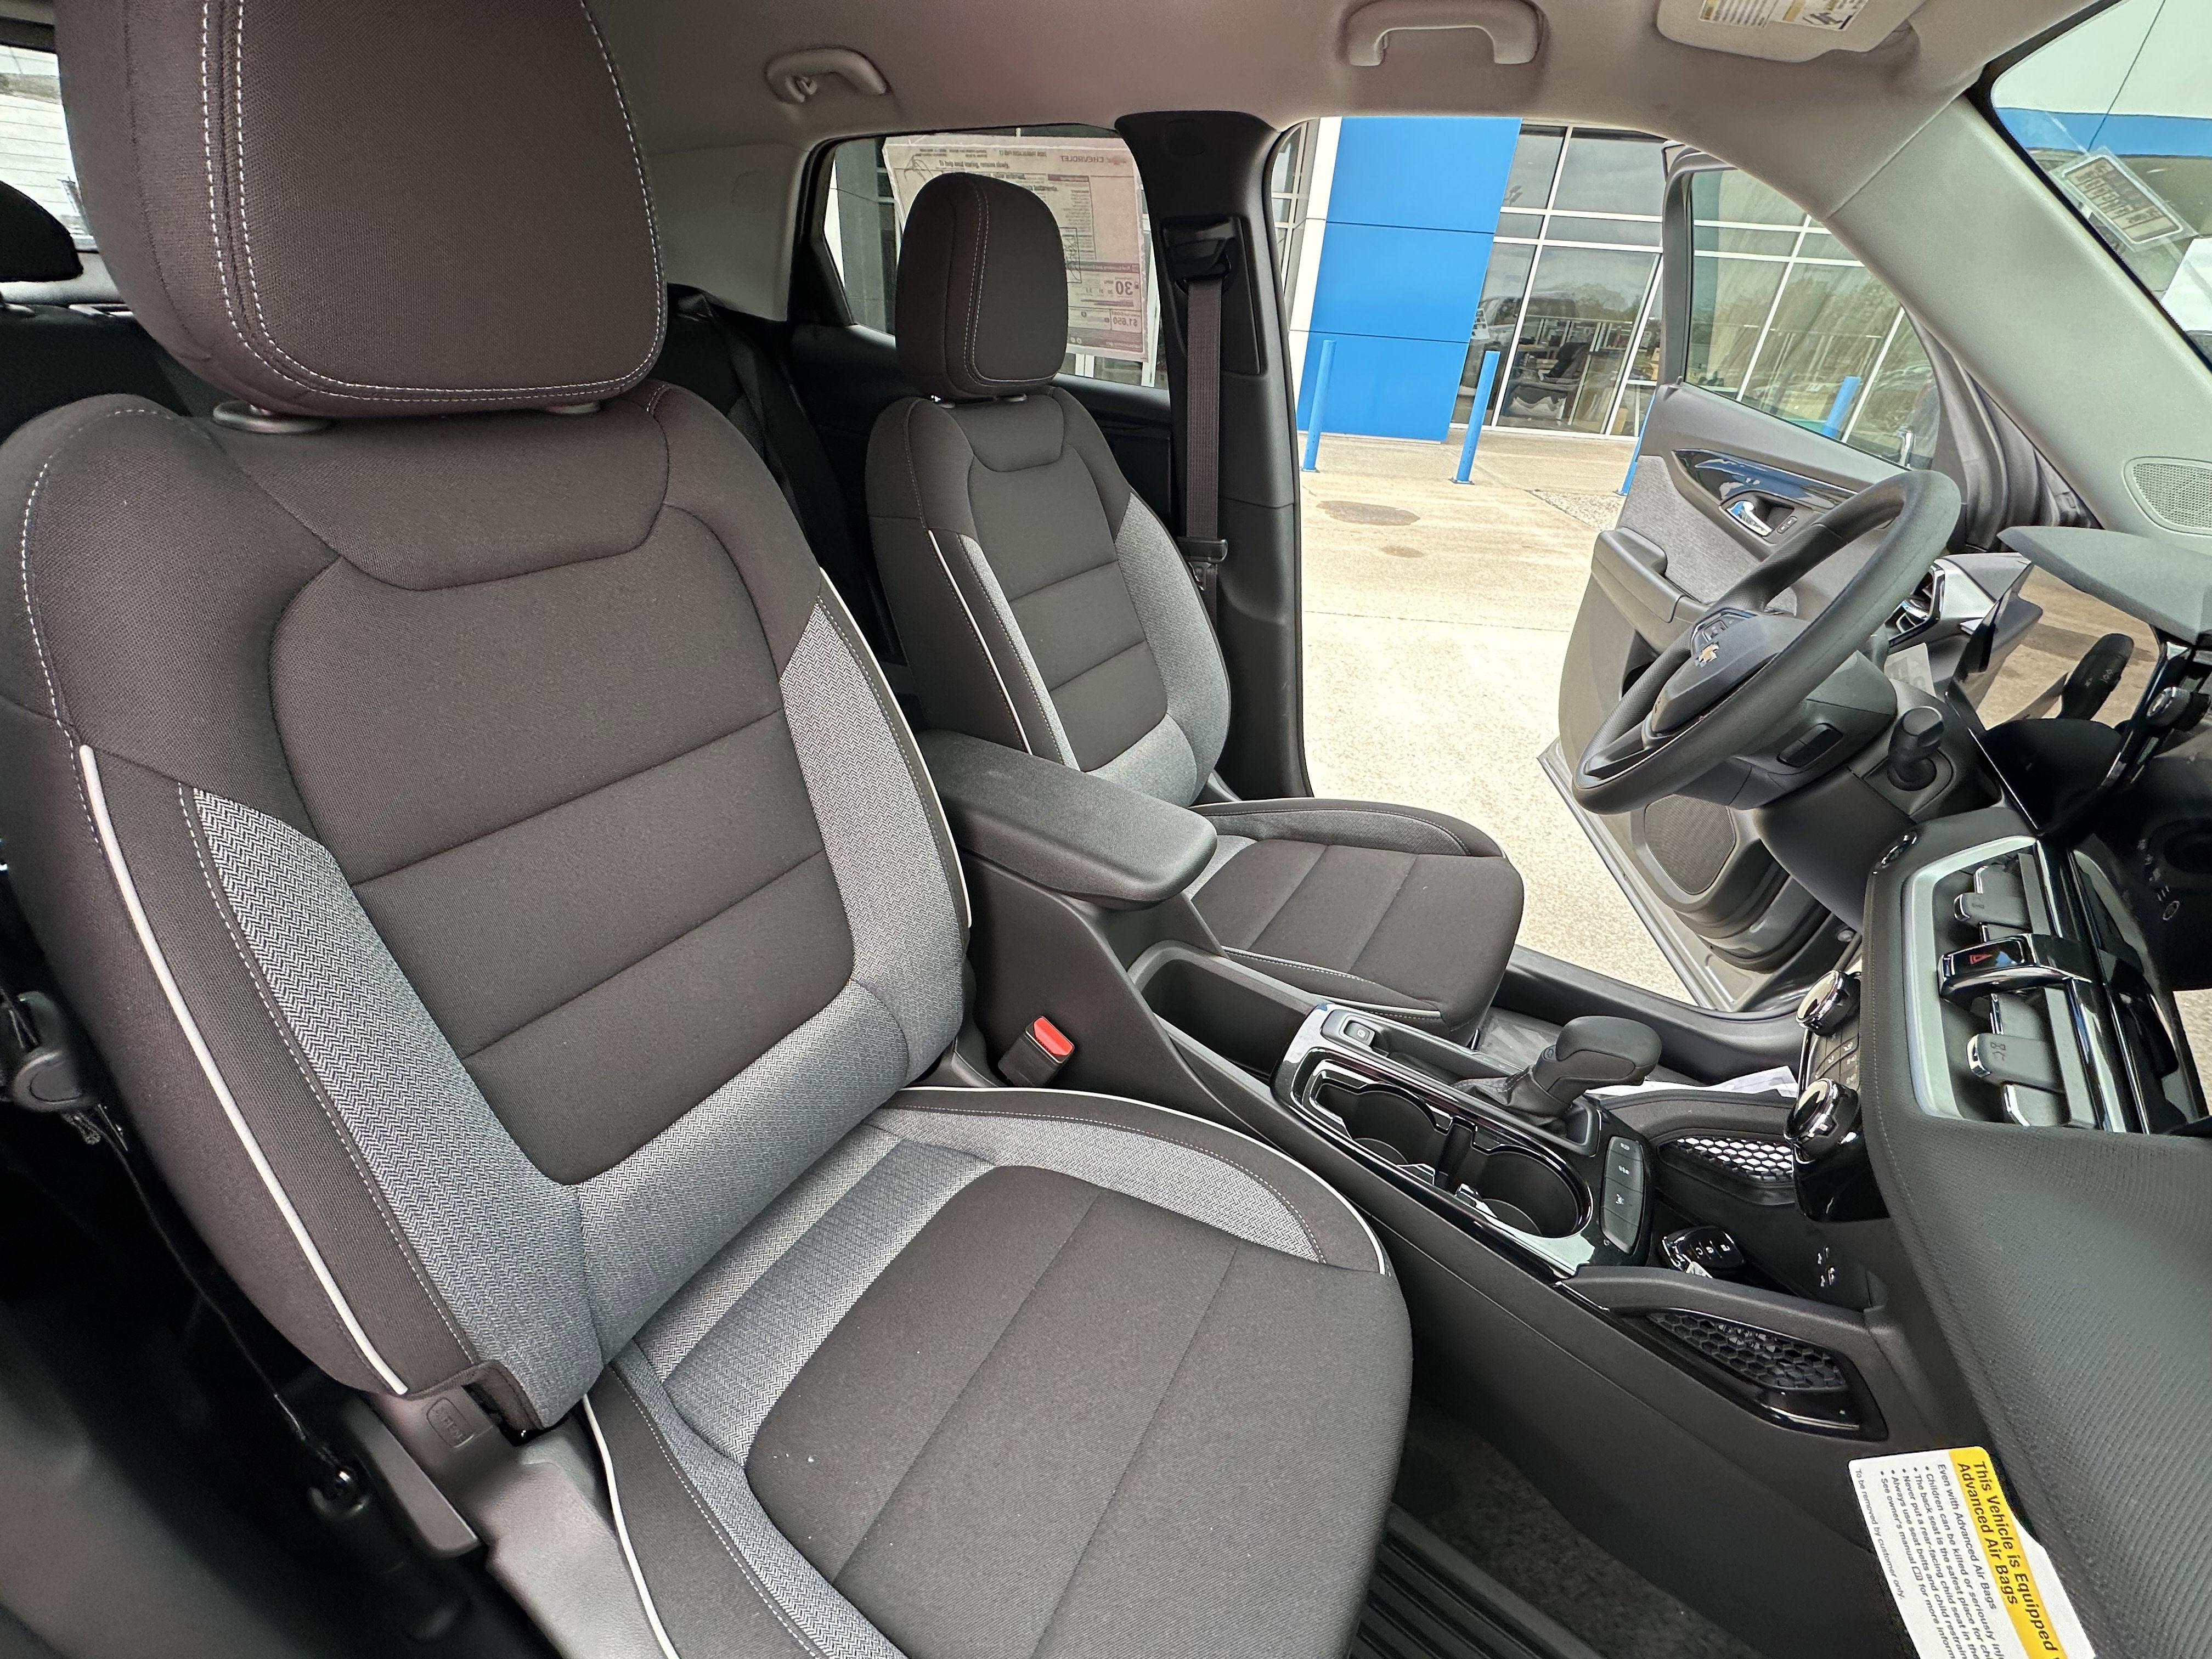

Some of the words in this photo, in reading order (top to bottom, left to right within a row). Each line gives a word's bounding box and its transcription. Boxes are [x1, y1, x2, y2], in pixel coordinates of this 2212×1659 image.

[1855, 1468, 1862, 1478] To
[1858, 1480, 1865, 1489] be
[1862, 1491, 1879, 1525] removed
[1874, 1527, 1882, 1537] by
[1937, 1464, 1951, 1487] Even
[1946, 1488, 1960, 1509] with
[1954, 1512, 1979, 1561] Advanced
[1972, 1564, 1985, 1579] Air
[1980, 1582, 1996, 1610] Bags
[1957, 1463, 1994, 1533] Advanced
[1985, 1538, 2002, 1561] Air
[1995, 1565, 2018, 1605] Bags
[1878, 1538, 1897, 1578] customer
[1881, 1478, 1890, 1493] See
[1887, 1496, 1902, 1529] owner's
[1899, 1531, 1917, 1564] manual
[1918, 1583, 1928, 1597] for
[1925, 1600, 1939, 1624] more
[1891, 1476, 1906, 1507] Always
[1903, 1509, 1912, 1525] use
[1909, 1527, 1921, 1546] seat
[1916, 1548, 1929, 1571] belts
[1926, 1573, 1939, 1591] and
[1934, 1594, 1951, 1618] child
[1893, 1579, 1905, 1600] only.
[1903, 1476, 1916, 1500] Never
[1910, 1503, 1922, 1516] put
[1920, 1527, 1943, 1578] rear-facing
[1940, 1581, 1956, 1604] child
[1951, 1606, 1966, 1628] seat
[1961, 1631, 1971, 1640] in
[1967, 1644, 1980, 1659] the
[1915, 1474, 1924, 1490] The
[1921, 1492, 1933, 1514] back
[1928, 1515, 1941, 1535] seat
[1936, 1537, 1943, 1545] is
[1940, 1548, 1950, 1562] the
[1946, 1565, 1964, 1594] safest
[1957, 1597, 1975, 1624] place
[1972, 1627, 1984, 1642] for
[1926, 1474, 1943, 1511] Children
[1940, 1513, 1950, 1530] can
[1946, 1533, 1956, 1545] be
[1952, 1548, 1969, 1575] killed
[1964, 1578, 1973, 1589] or
[1969, 1592, 1996, 1640] seriously
[1991, 1643, 2005, 1659] inj
[1973, 1461, 1992, 1491] This
[1987, 1495, 2014, 1549] Vehicle
[2007, 1554, 2021, 1568] is
[2014, 1573, 2058, 1651] Equipped
